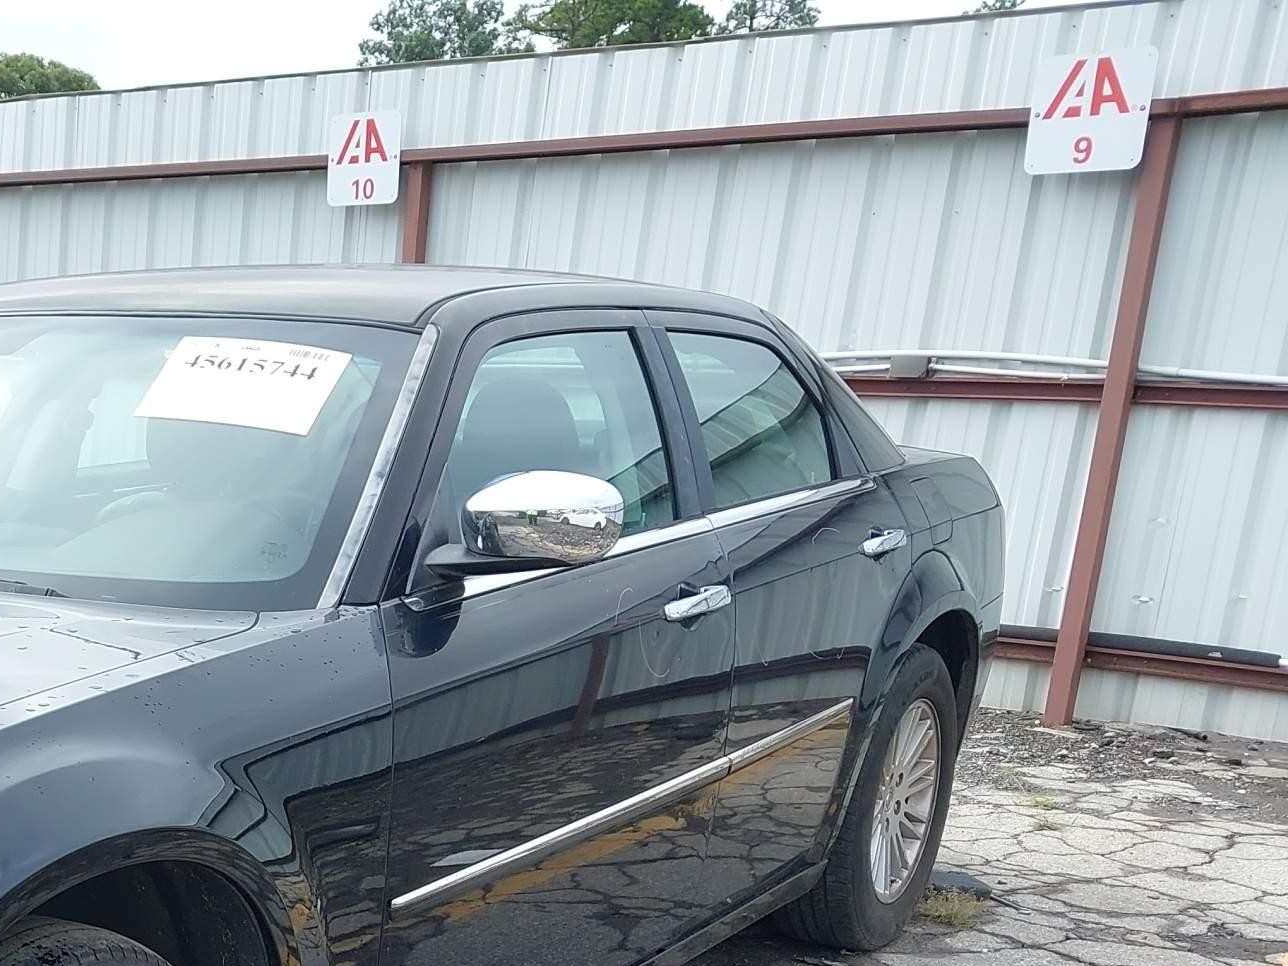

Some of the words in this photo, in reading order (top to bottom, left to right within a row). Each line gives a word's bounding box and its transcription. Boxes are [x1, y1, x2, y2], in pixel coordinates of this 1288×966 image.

[1072, 136, 1093, 164] 9
[351, 178, 375, 200] 10
[184, 353, 319, 381] 45615744
